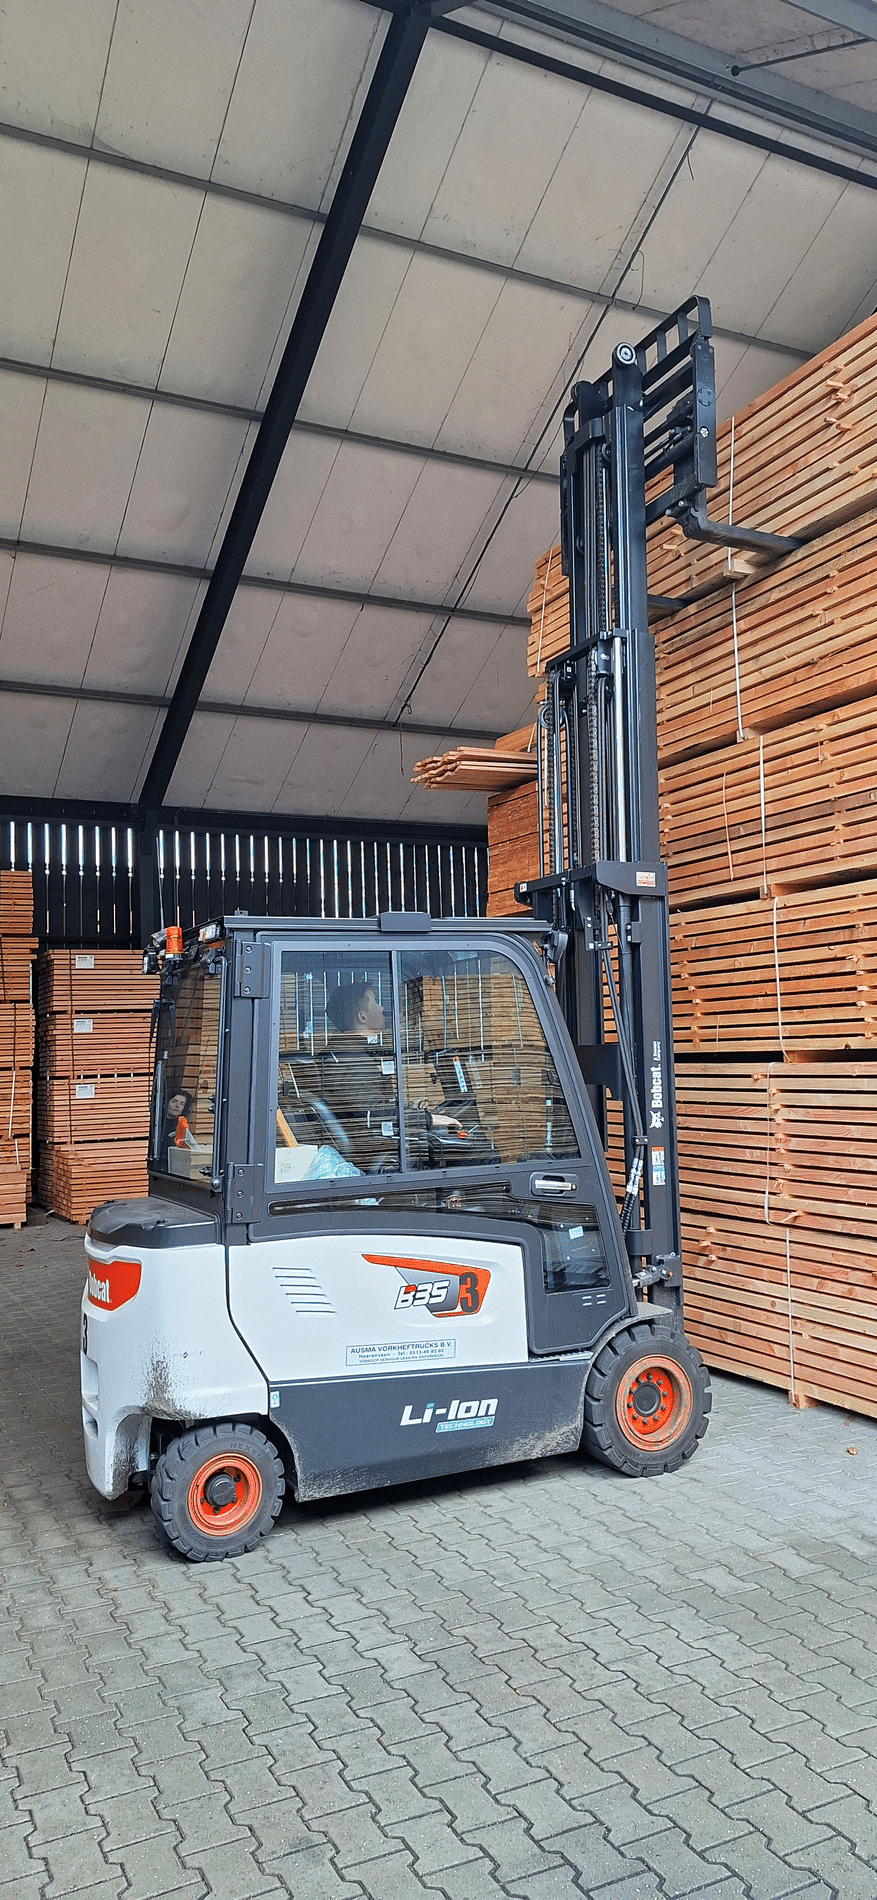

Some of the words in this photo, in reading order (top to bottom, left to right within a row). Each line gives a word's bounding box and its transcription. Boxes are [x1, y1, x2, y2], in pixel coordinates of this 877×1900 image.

[394, 1280, 450, 1310] B35
[460, 1271, 479, 1313] 3
[378, 1342, 439, 1352] VORKHEFTRUCKS
[400, 1398, 499, 1426] Li-Ion
